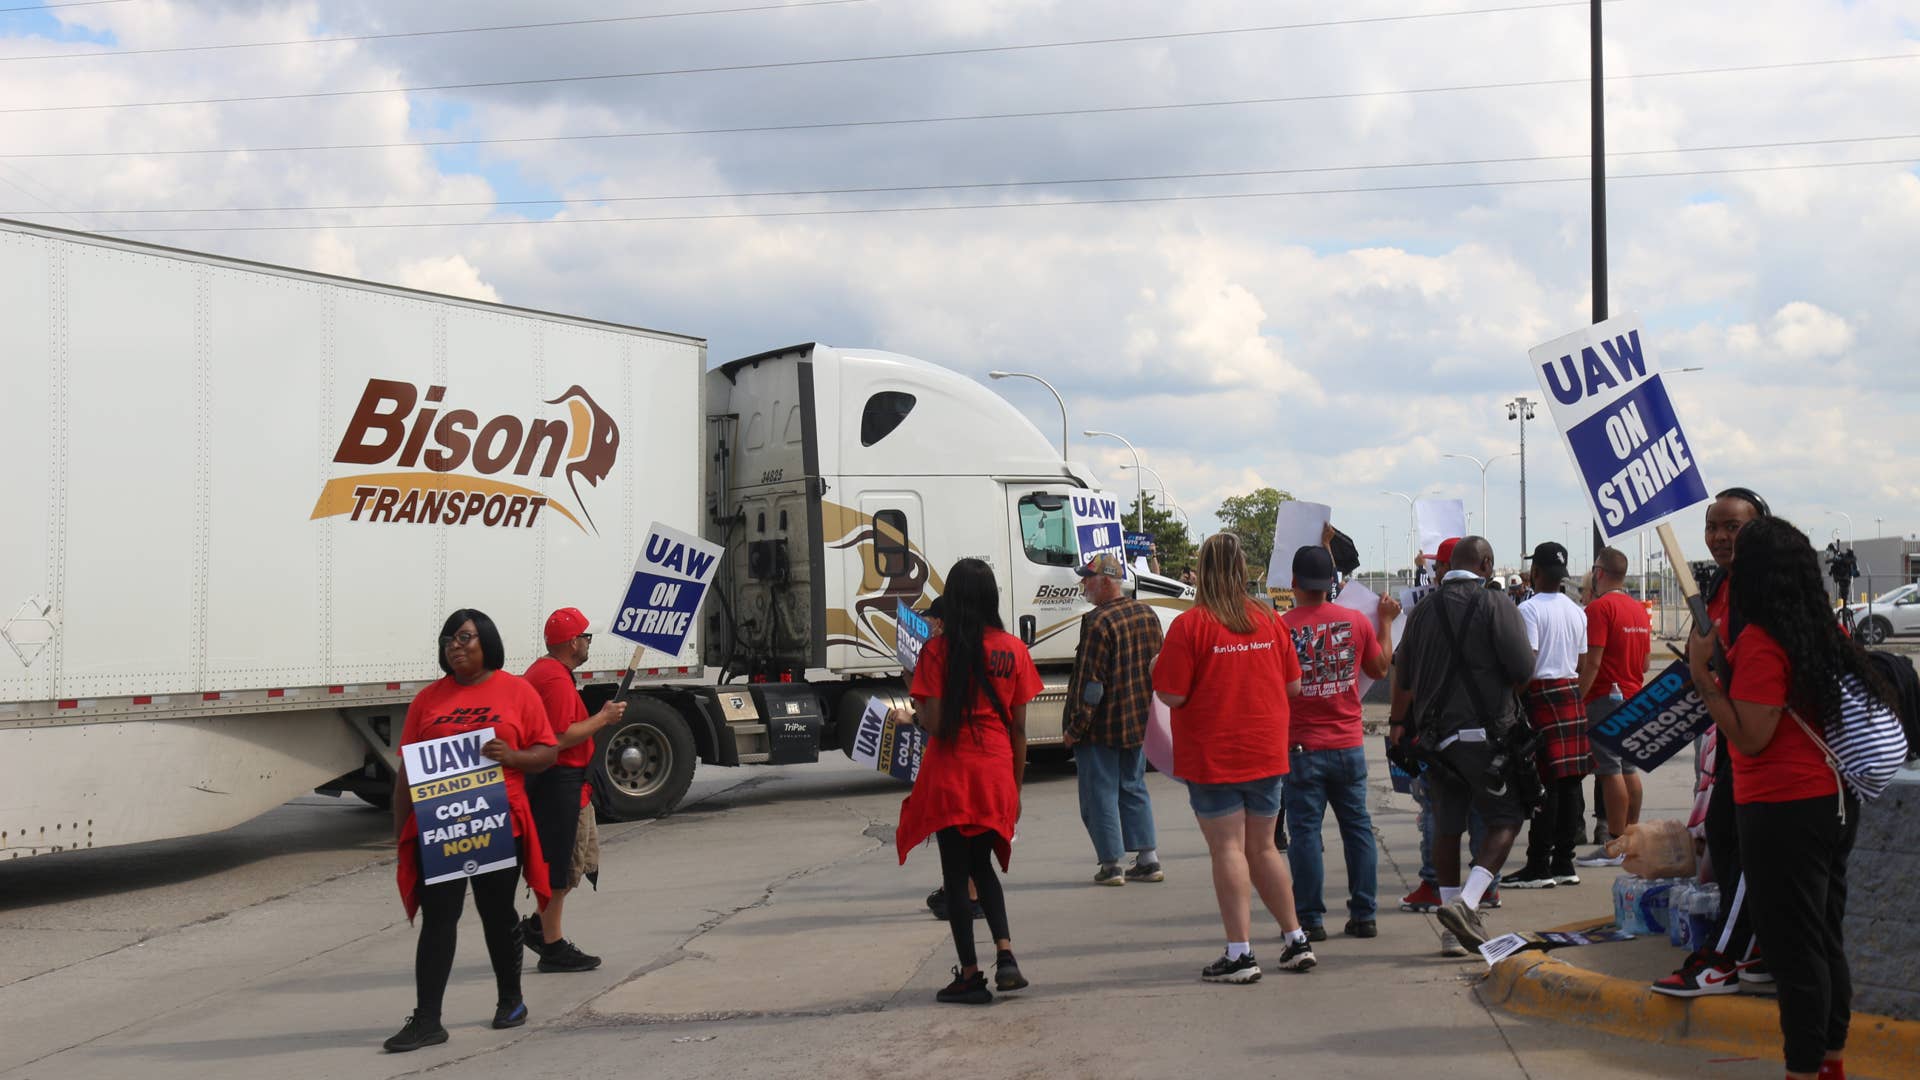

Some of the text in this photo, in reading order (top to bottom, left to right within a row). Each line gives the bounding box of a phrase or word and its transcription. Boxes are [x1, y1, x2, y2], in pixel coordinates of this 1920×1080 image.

[1542, 329, 1646, 405] UAW
[333, 378, 568, 478] Bison
[1605, 400, 1649, 460] ON
[1597, 426, 1691, 527] STRIKE
[350, 487, 548, 528] TRANSPORT
[1073, 496, 1115, 520] UAW
[1092, 526, 1110, 548] ON
[645, 533, 715, 580] UAW
[1083, 545, 1123, 565] STKE
[649, 582, 681, 607] ON
[1036, 584, 1079, 598] Bison
[617, 607, 690, 636] STRIKE
[898, 624, 923, 655] STRON
[432, 715, 503, 725] DEAL
[1596, 672, 1684, 737] UNITED
[784, 723, 806, 732] TriPac
[856, 707, 883, 758] UAW
[1635, 703, 1709, 760] CONTRAC
[419, 735, 480, 774] UAW
[881, 733, 893, 771] STAND
[898, 731, 911, 767] COLA
[910, 753, 922, 782] FAIR
[417, 770, 498, 799] STAND UP
[436, 796, 490, 820] COLA
[423, 812, 507, 845] FAIR PAY
[443, 832, 491, 857] NOW
